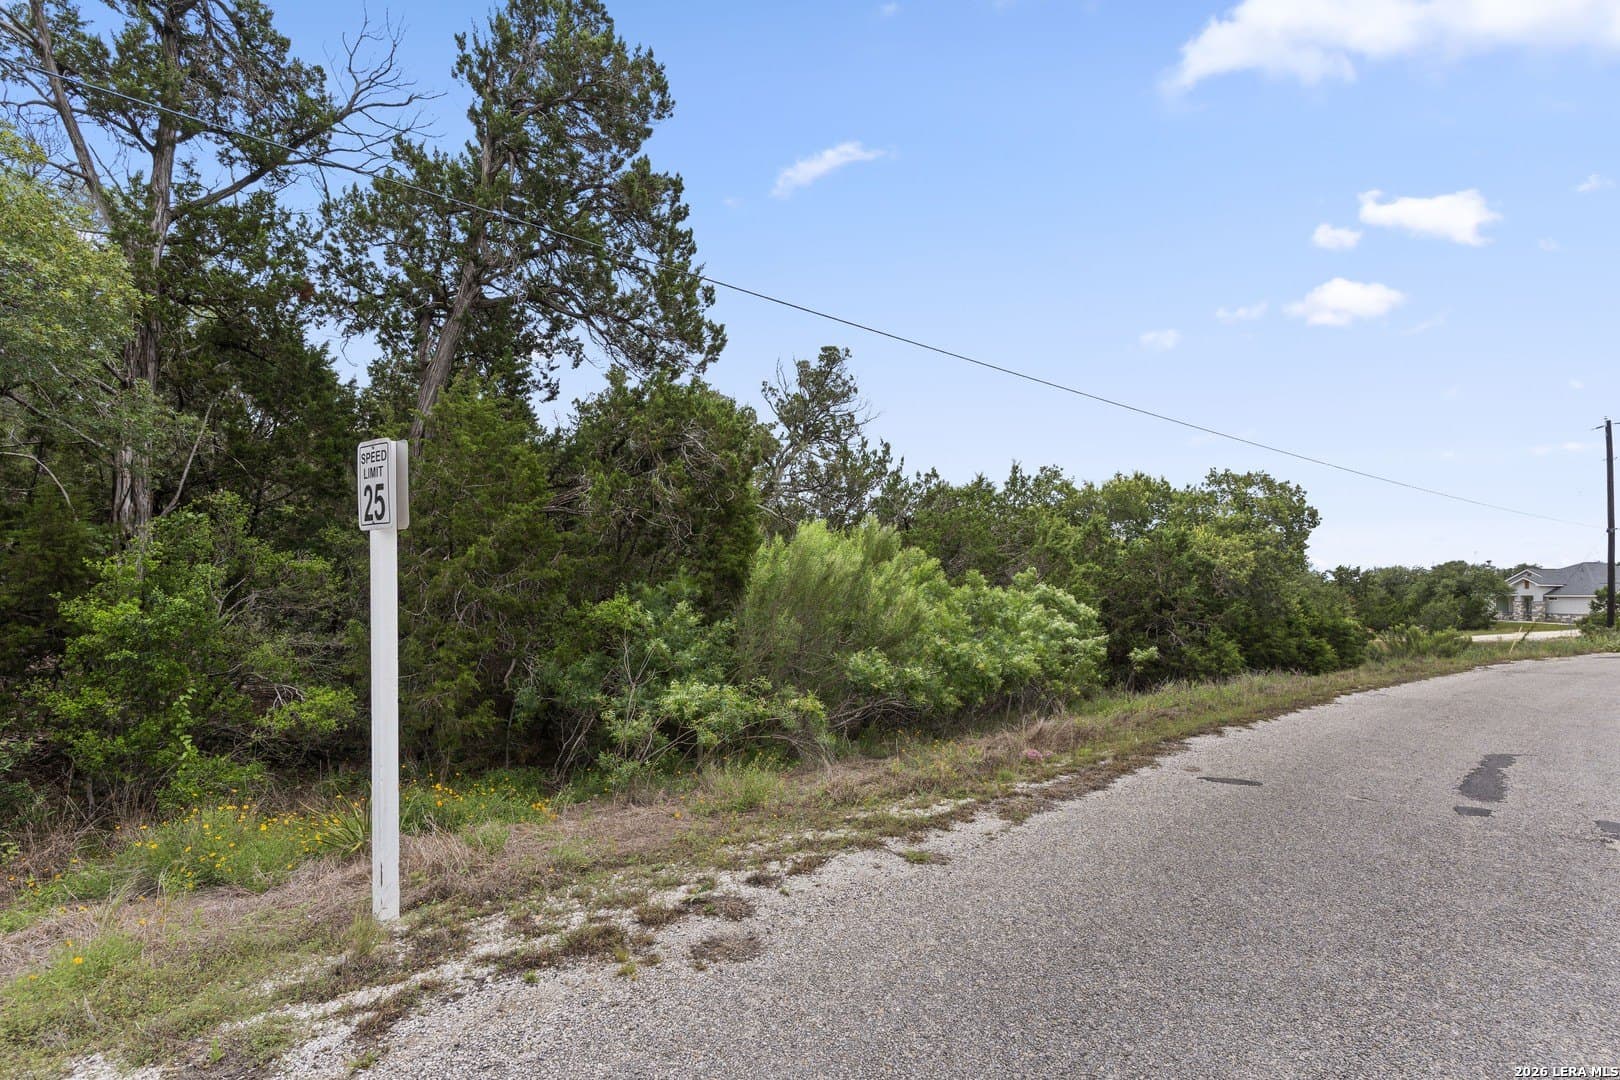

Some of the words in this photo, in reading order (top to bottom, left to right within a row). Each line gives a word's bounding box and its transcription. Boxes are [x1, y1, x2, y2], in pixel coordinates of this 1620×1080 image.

[361, 449, 387, 465] SPEED
[363, 466, 384, 480] LIMIT
[363, 483, 386, 521] 25
